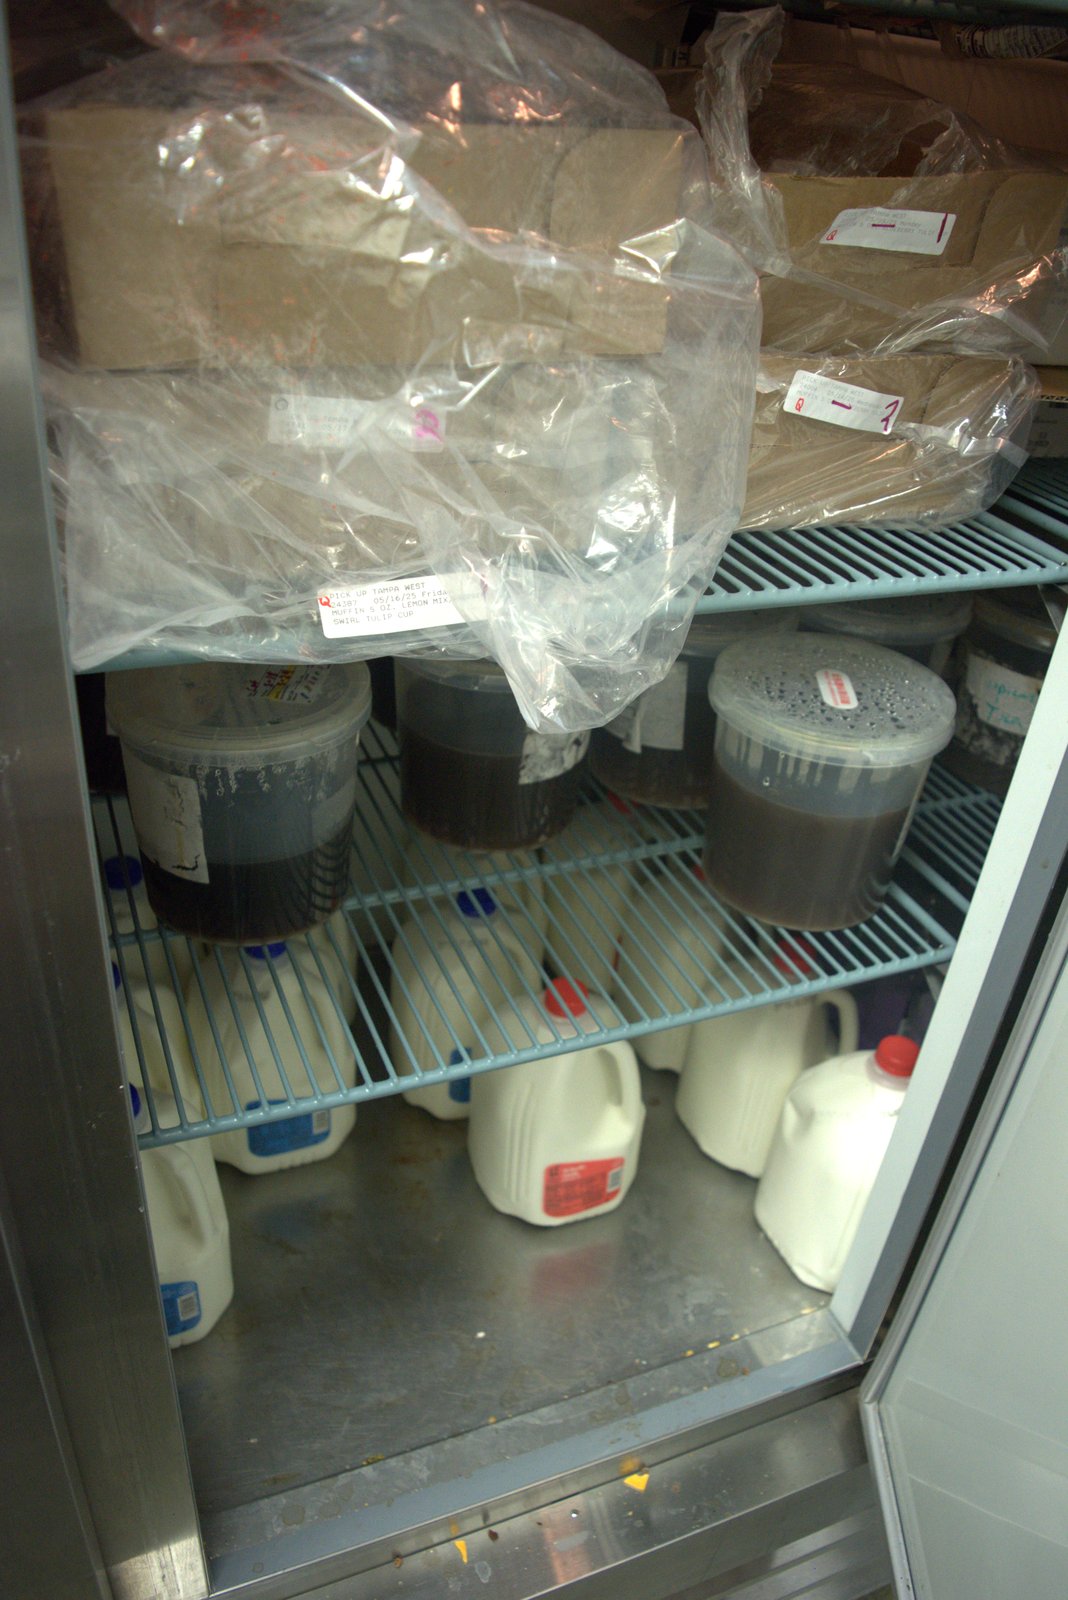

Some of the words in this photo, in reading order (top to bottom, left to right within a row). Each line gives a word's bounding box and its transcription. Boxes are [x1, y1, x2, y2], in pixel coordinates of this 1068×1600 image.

[373, 586, 399, 595] TAMPA
[404, 582, 425, 591] WEST
[373, 592, 416, 605] 05/16/25
[331, 608, 365, 616] MUFFIN
[402, 600, 428, 609] LEMON
[333, 617, 360, 625] SWIRL
[366, 613, 392, 622] TULIP
[398, 610, 413, 618] CUP
